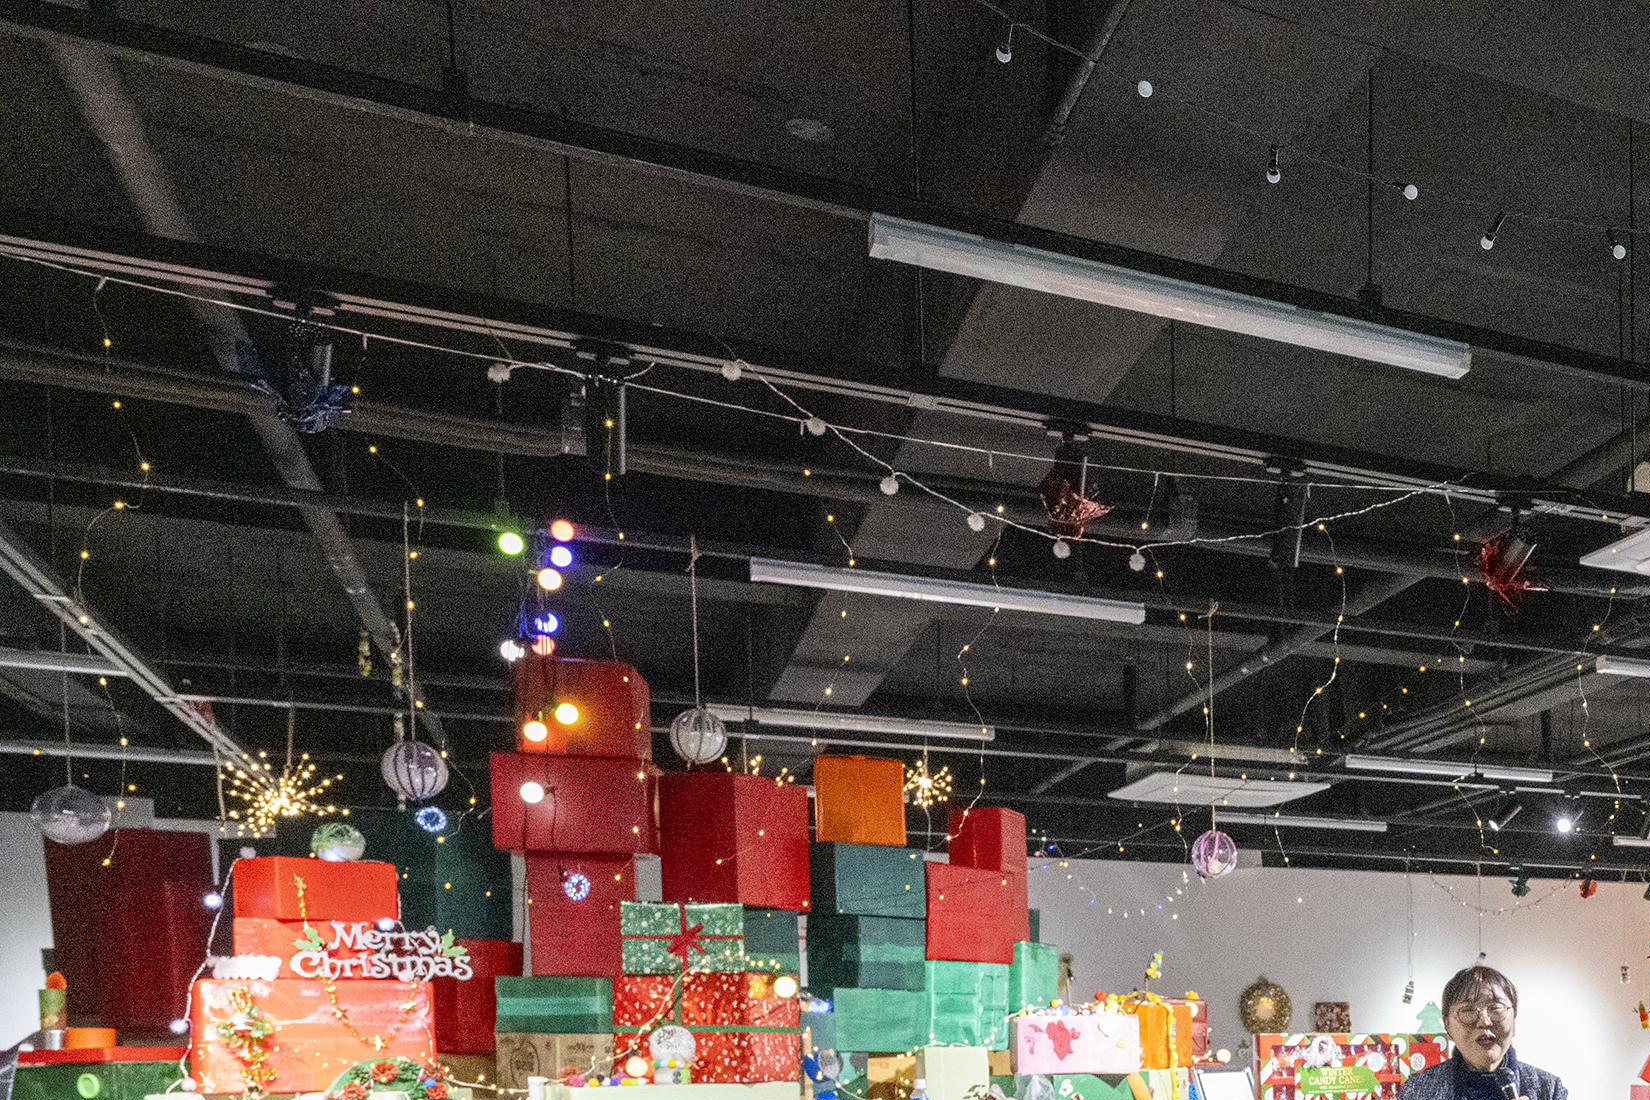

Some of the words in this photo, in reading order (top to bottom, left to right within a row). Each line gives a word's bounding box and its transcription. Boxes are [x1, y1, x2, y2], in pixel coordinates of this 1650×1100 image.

[329, 920, 441, 955] Merry
[289, 950, 474, 981] Christmas
[1308, 1076, 1337, 1085] CANDY
[1338, 1075, 1366, 1084] CANES
[1320, 1067, 1353, 1077] WINTER
